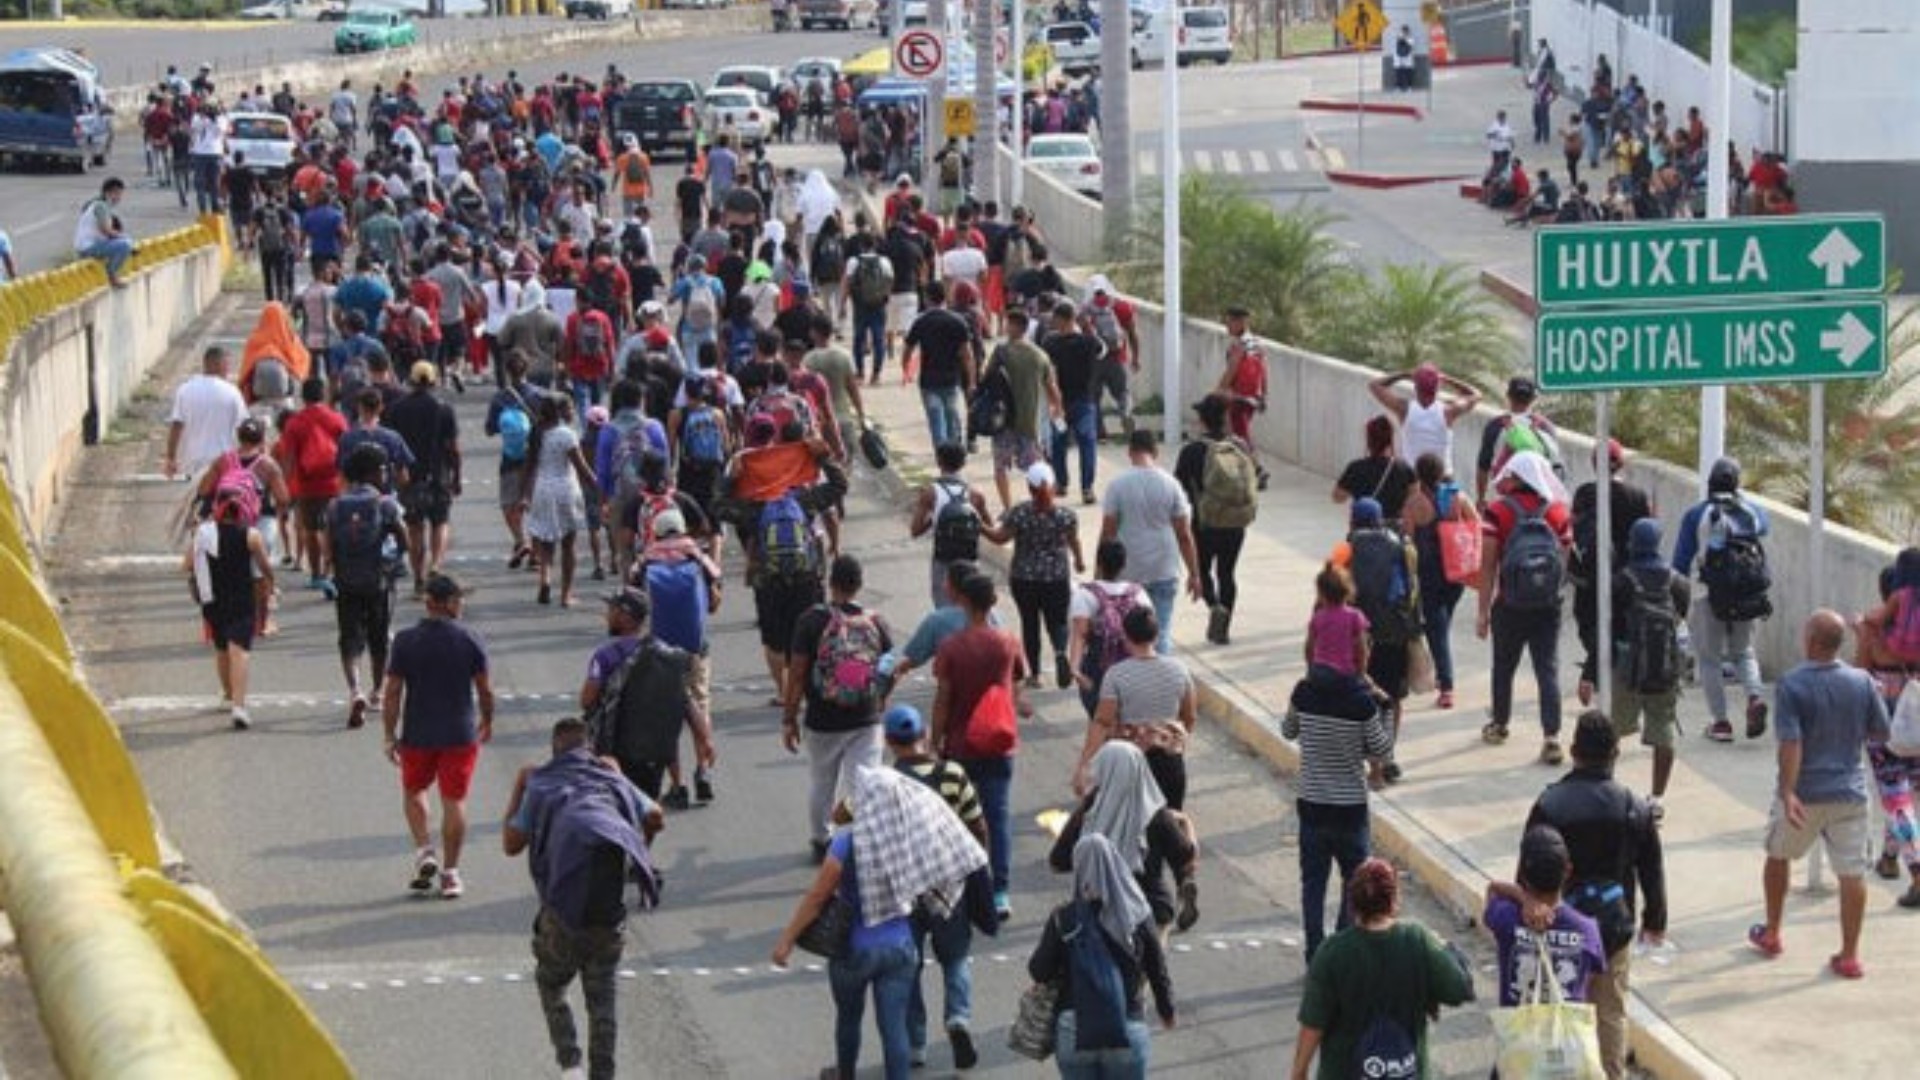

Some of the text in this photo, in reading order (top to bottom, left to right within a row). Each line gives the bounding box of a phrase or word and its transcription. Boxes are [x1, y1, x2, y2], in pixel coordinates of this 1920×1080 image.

[1558, 236, 1768, 289] HUIXTLA
[1546, 320, 1795, 373] HOSPITAL IMSS
